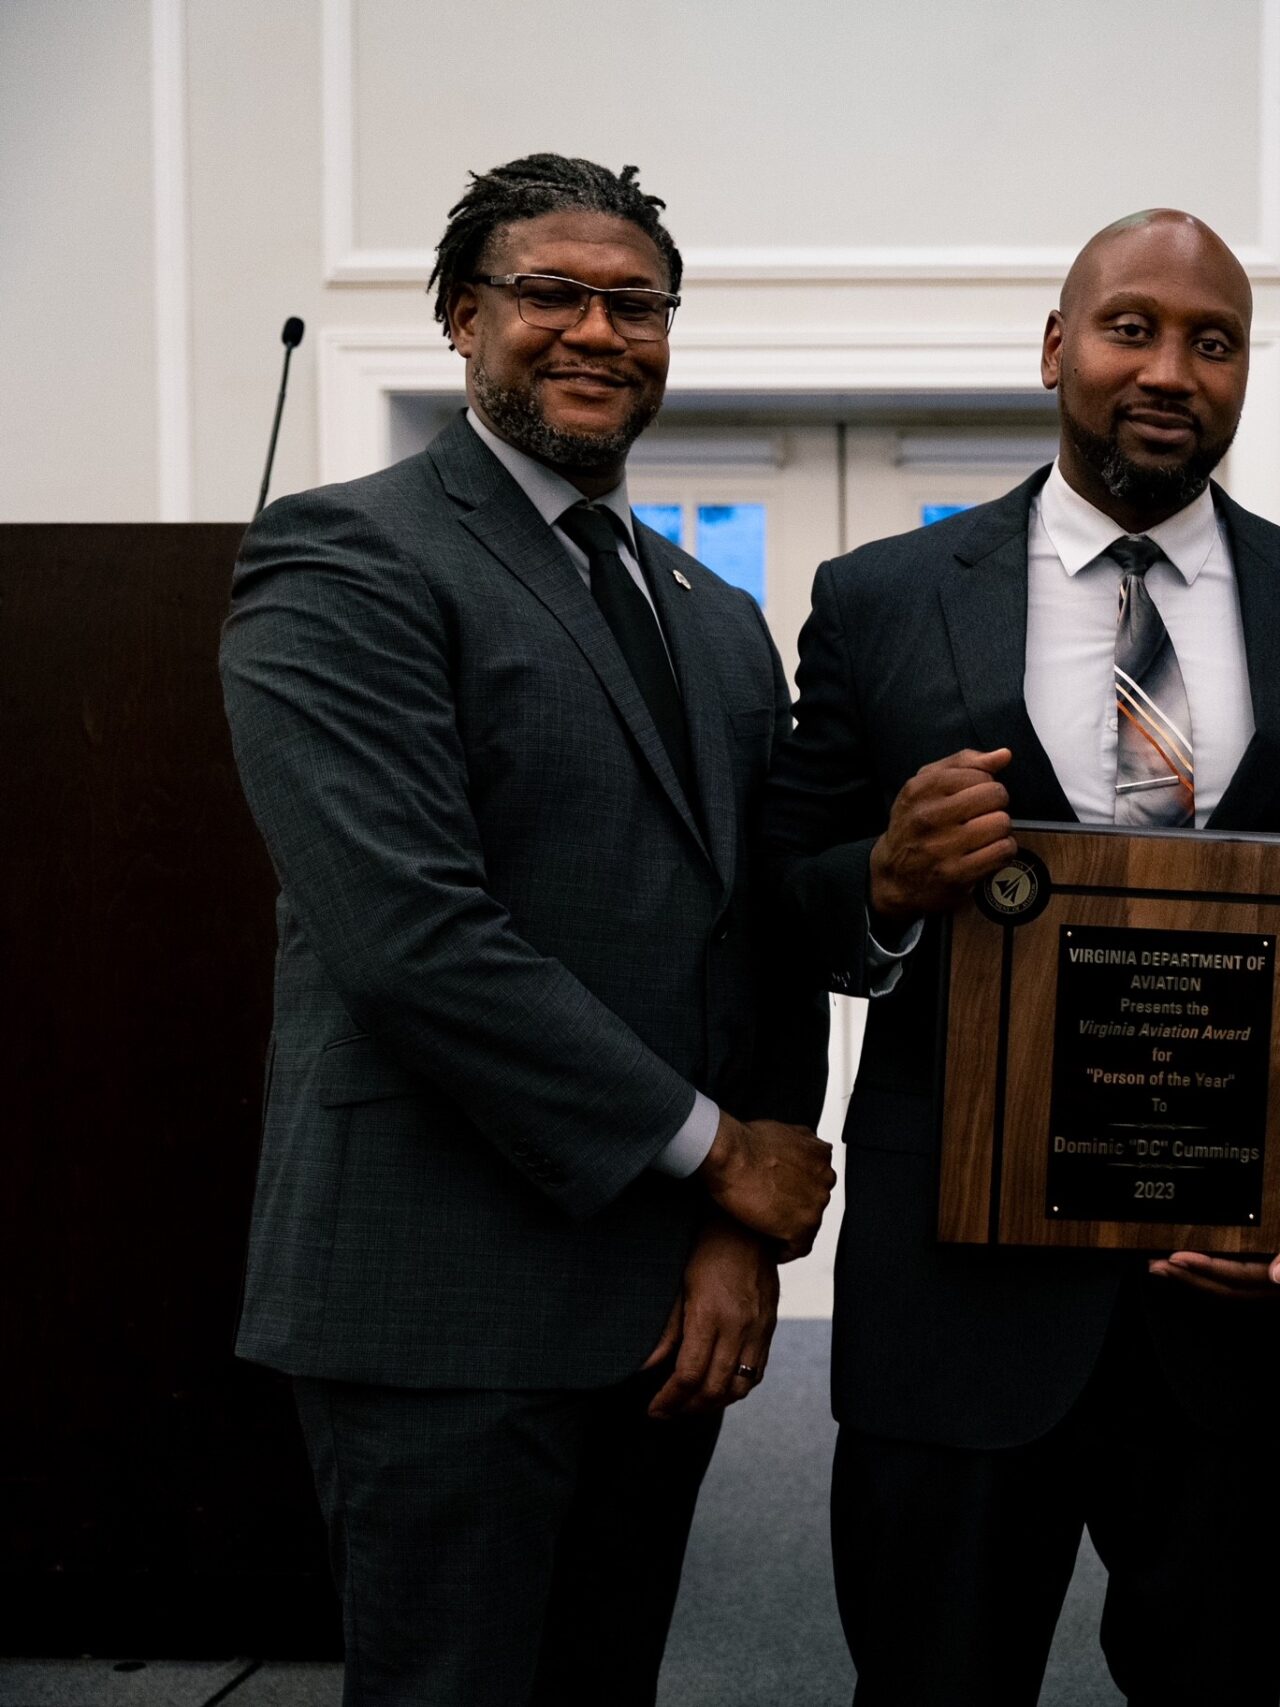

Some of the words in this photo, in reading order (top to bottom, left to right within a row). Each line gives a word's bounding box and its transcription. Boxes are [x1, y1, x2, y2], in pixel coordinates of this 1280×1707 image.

[1069, 948, 1137, 966] VIRGINIA
[1141, 951, 1244, 970] DEPARTMENT
[1246, 956, 1266, 971] OF
[1130, 974, 1201, 992] AVIATION
[1120, 998, 1183, 1015] Presents
[1186, 1001, 1209, 1016] the
[1078, 1020, 1134, 1038] Virginia
[1138, 1023, 1199, 1039] Aviation
[1201, 1025, 1251, 1041] Award
[1152, 1047, 1173, 1062] for
[1086, 1067, 1145, 1085] "Person
[1149, 1071, 1165, 1086] of
[1167, 1072, 1191, 1087] the
[1151, 1097, 1168, 1112] To
[1053, 1136, 1125, 1155] Dominic
[1172, 1141, 1260, 1164] Cummings
[1134, 1181, 1175, 1199] 2023
